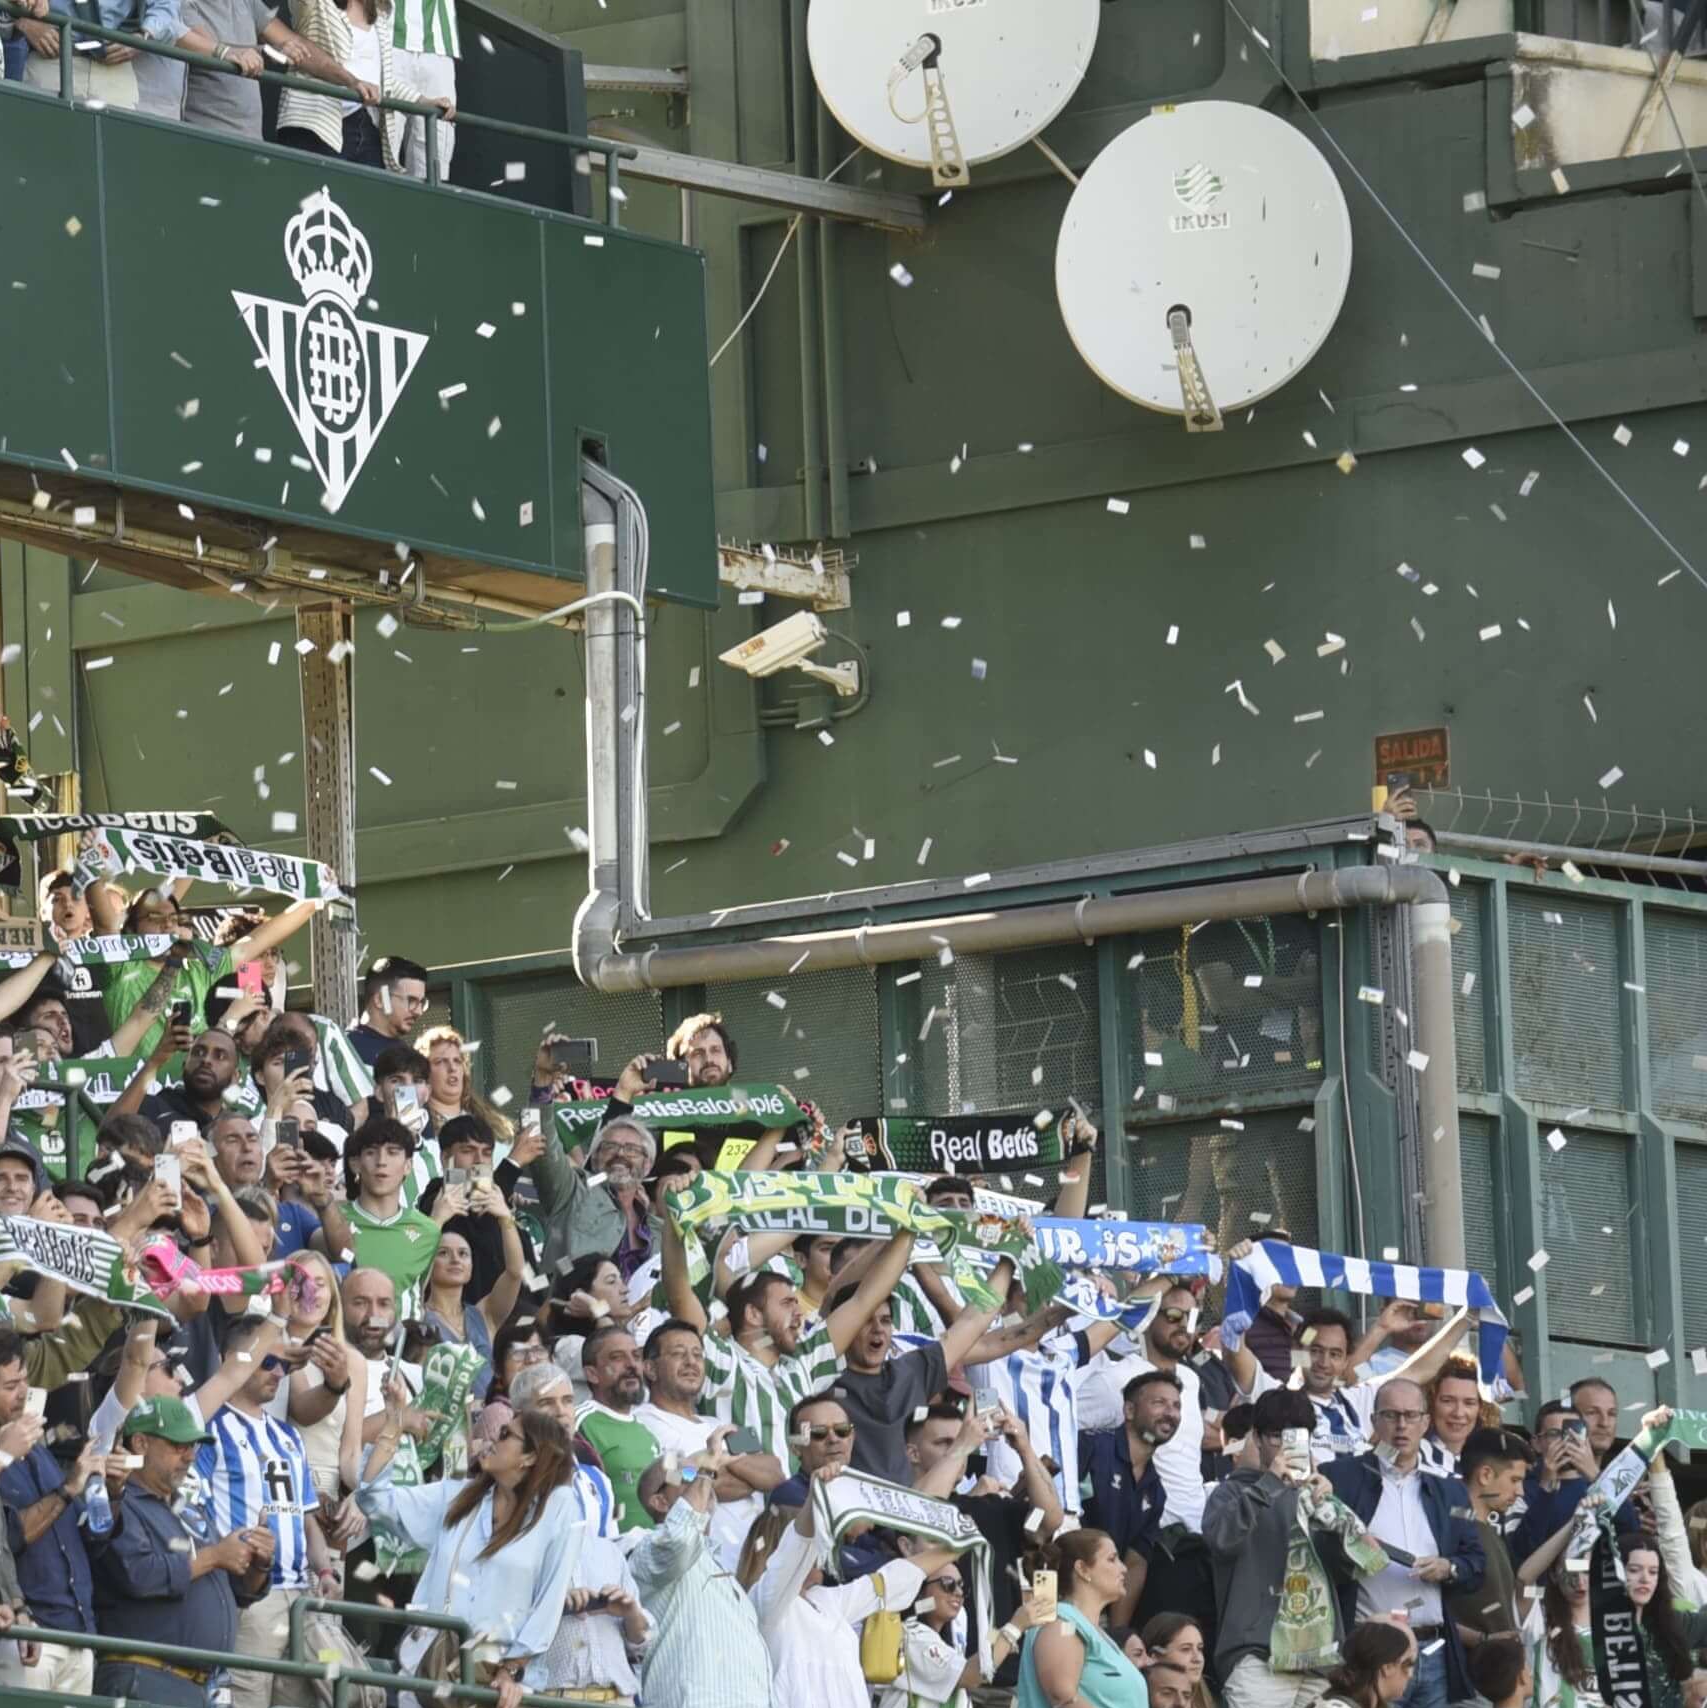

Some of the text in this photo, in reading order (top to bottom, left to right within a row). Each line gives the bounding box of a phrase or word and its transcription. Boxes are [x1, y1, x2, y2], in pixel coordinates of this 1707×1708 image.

[1173, 212, 1230, 232] IKUSI
[1379, 735, 1442, 763] SALIDA
[725, 1141, 752, 1157] 232
[931, 1126, 1038, 1164] Real Betis
